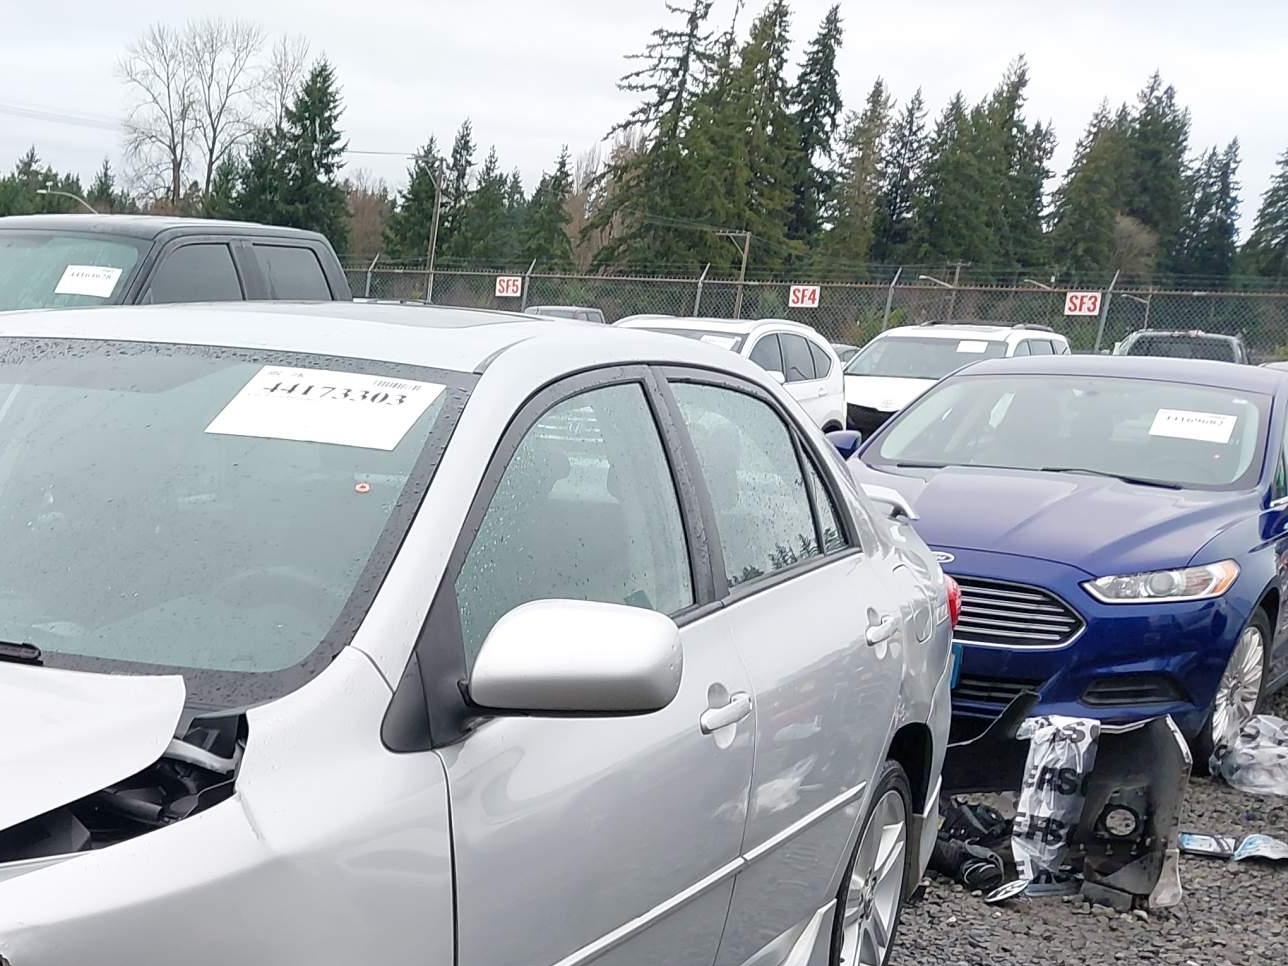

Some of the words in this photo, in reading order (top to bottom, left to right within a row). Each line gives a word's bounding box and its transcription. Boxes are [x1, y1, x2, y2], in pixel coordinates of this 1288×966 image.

[497, 278, 519, 294] SF5
[792, 288, 816, 304] SF4
[1068, 295, 1097, 312] SF3
[263, 381, 409, 406] 44173303
